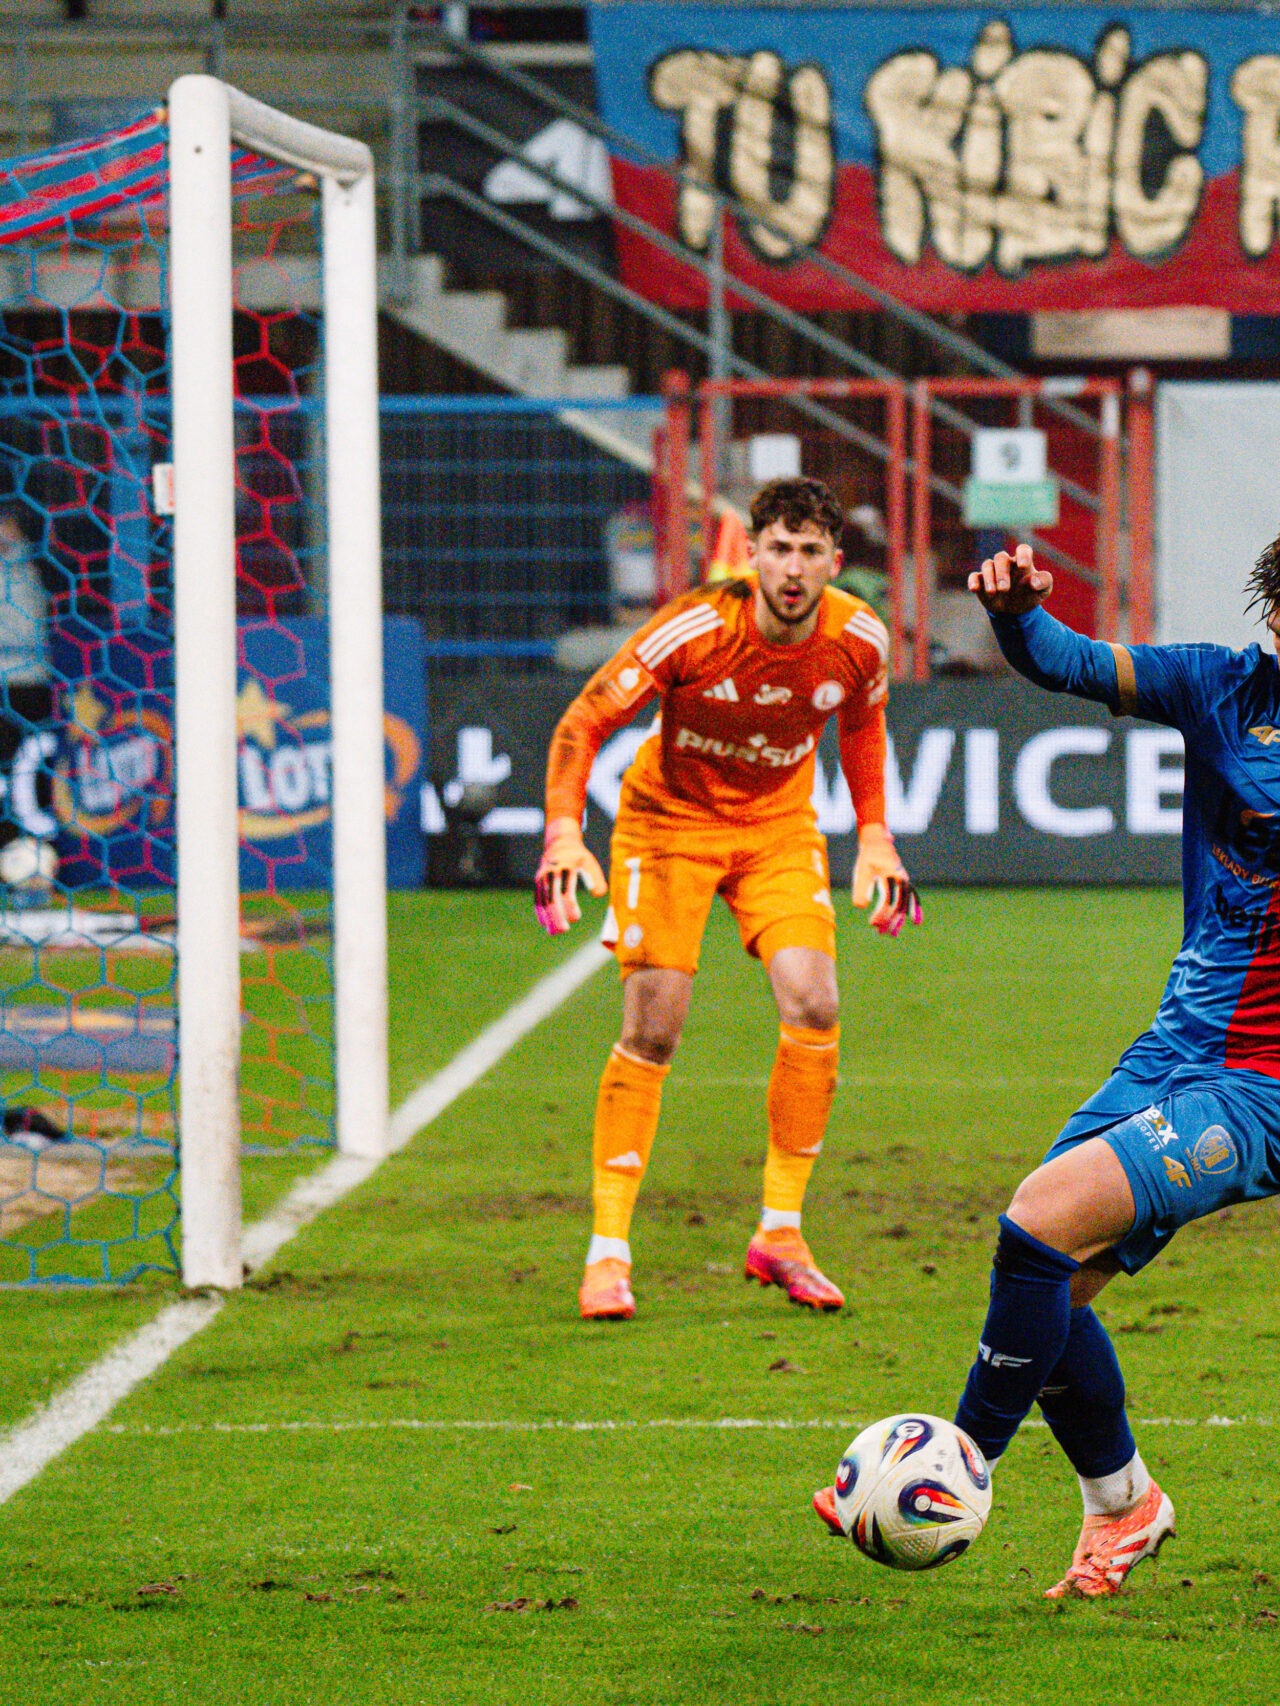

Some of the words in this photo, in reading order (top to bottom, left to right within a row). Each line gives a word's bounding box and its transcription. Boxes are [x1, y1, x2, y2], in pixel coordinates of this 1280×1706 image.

[646, 46, 836, 264] TU
[240, 743, 335, 812] LOT
[624, 857, 641, 910] 1
[1162, 1156, 1193, 1188] 4F
